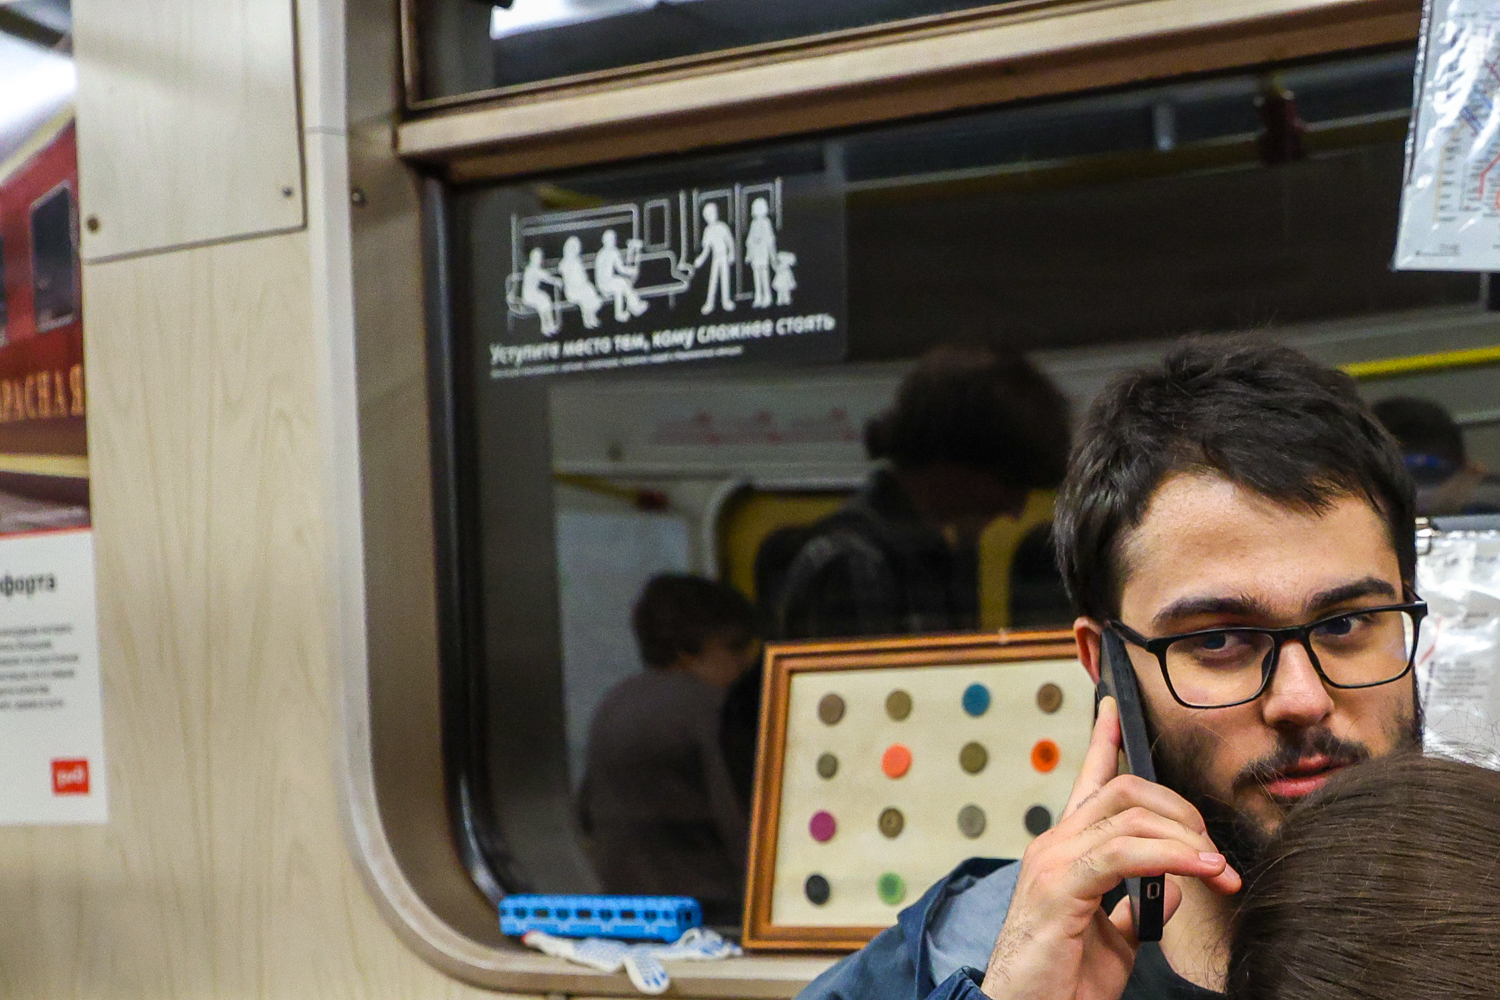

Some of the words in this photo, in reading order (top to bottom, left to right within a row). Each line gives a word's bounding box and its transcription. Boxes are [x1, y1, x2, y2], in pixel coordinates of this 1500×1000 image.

[489, 341, 561, 368] Уступите
[562, 335, 612, 358] место
[652, 327, 695, 350] кому
[697, 318, 774, 344] сложнее
[775, 313, 836, 336] стоять
[0, 364, 85, 423] РАСНАЯ
